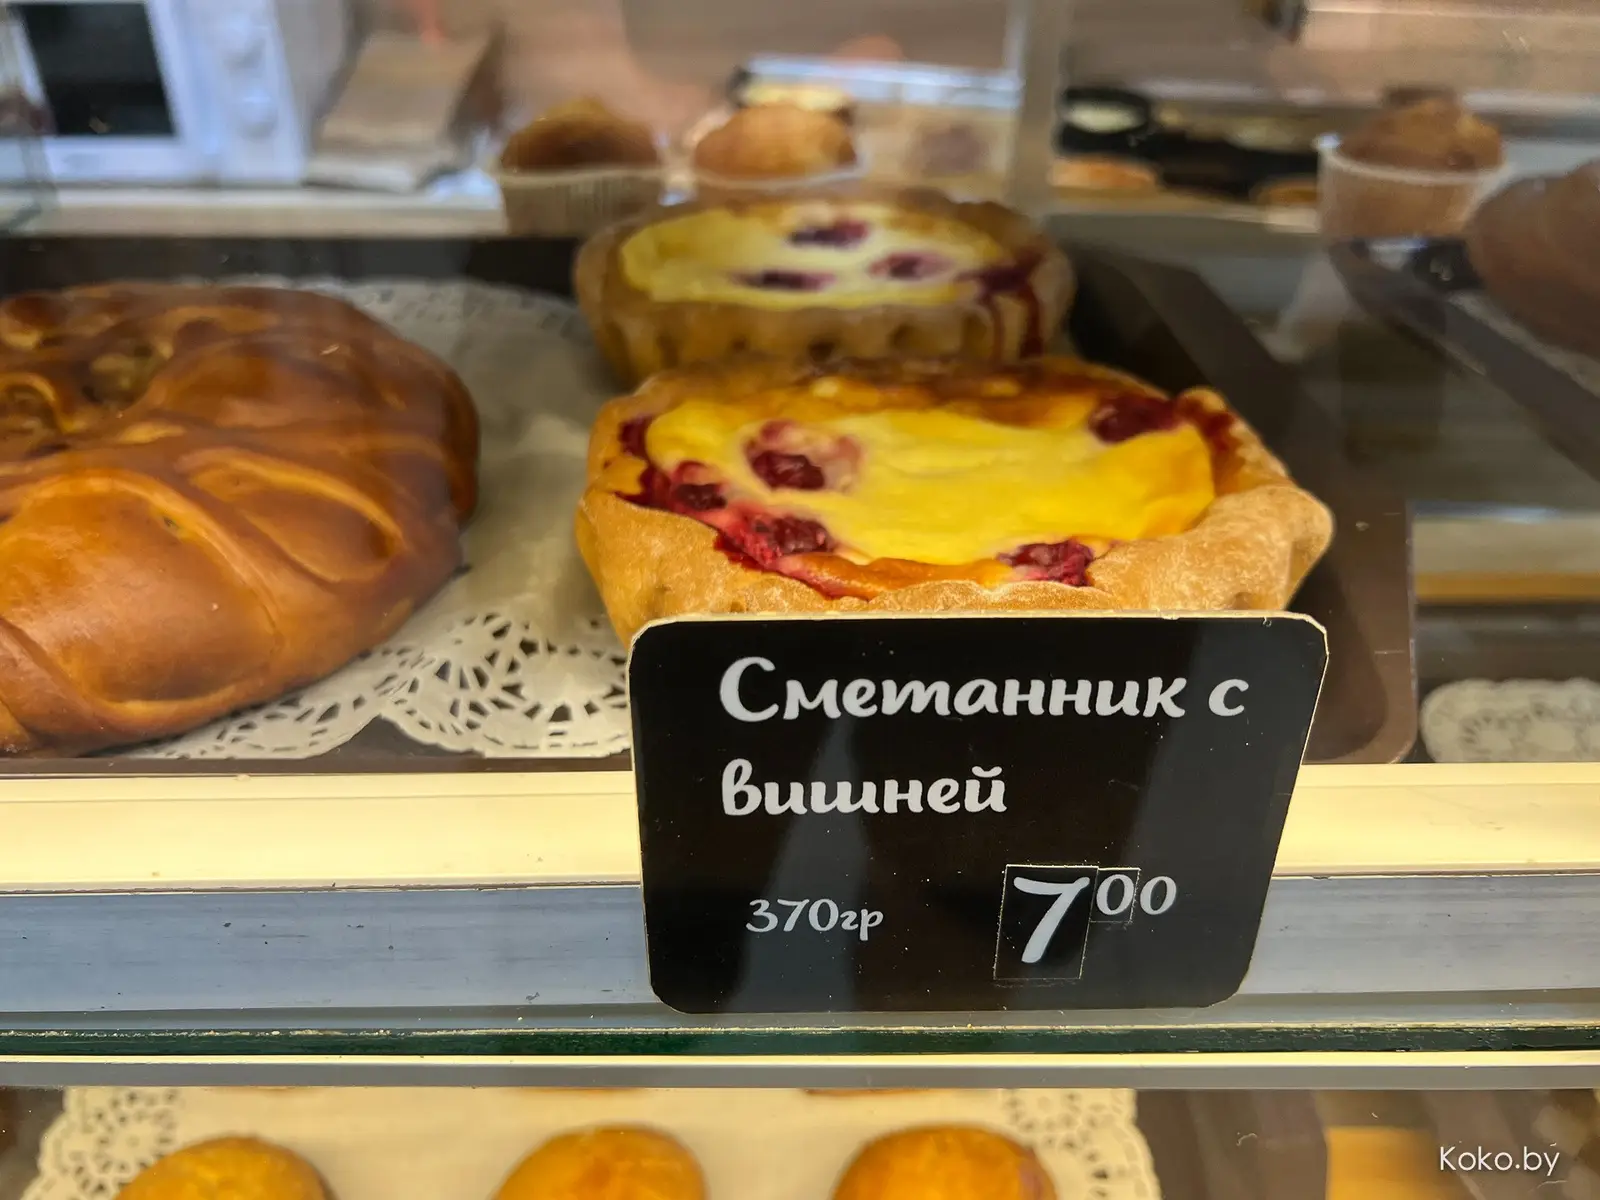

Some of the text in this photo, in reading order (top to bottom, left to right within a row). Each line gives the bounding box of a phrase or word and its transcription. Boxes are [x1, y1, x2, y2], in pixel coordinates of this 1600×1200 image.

[719, 656, 1249, 722] Сметанник с
[721, 758, 1007, 816] вишней
[745, 898, 884, 942] 370гр
